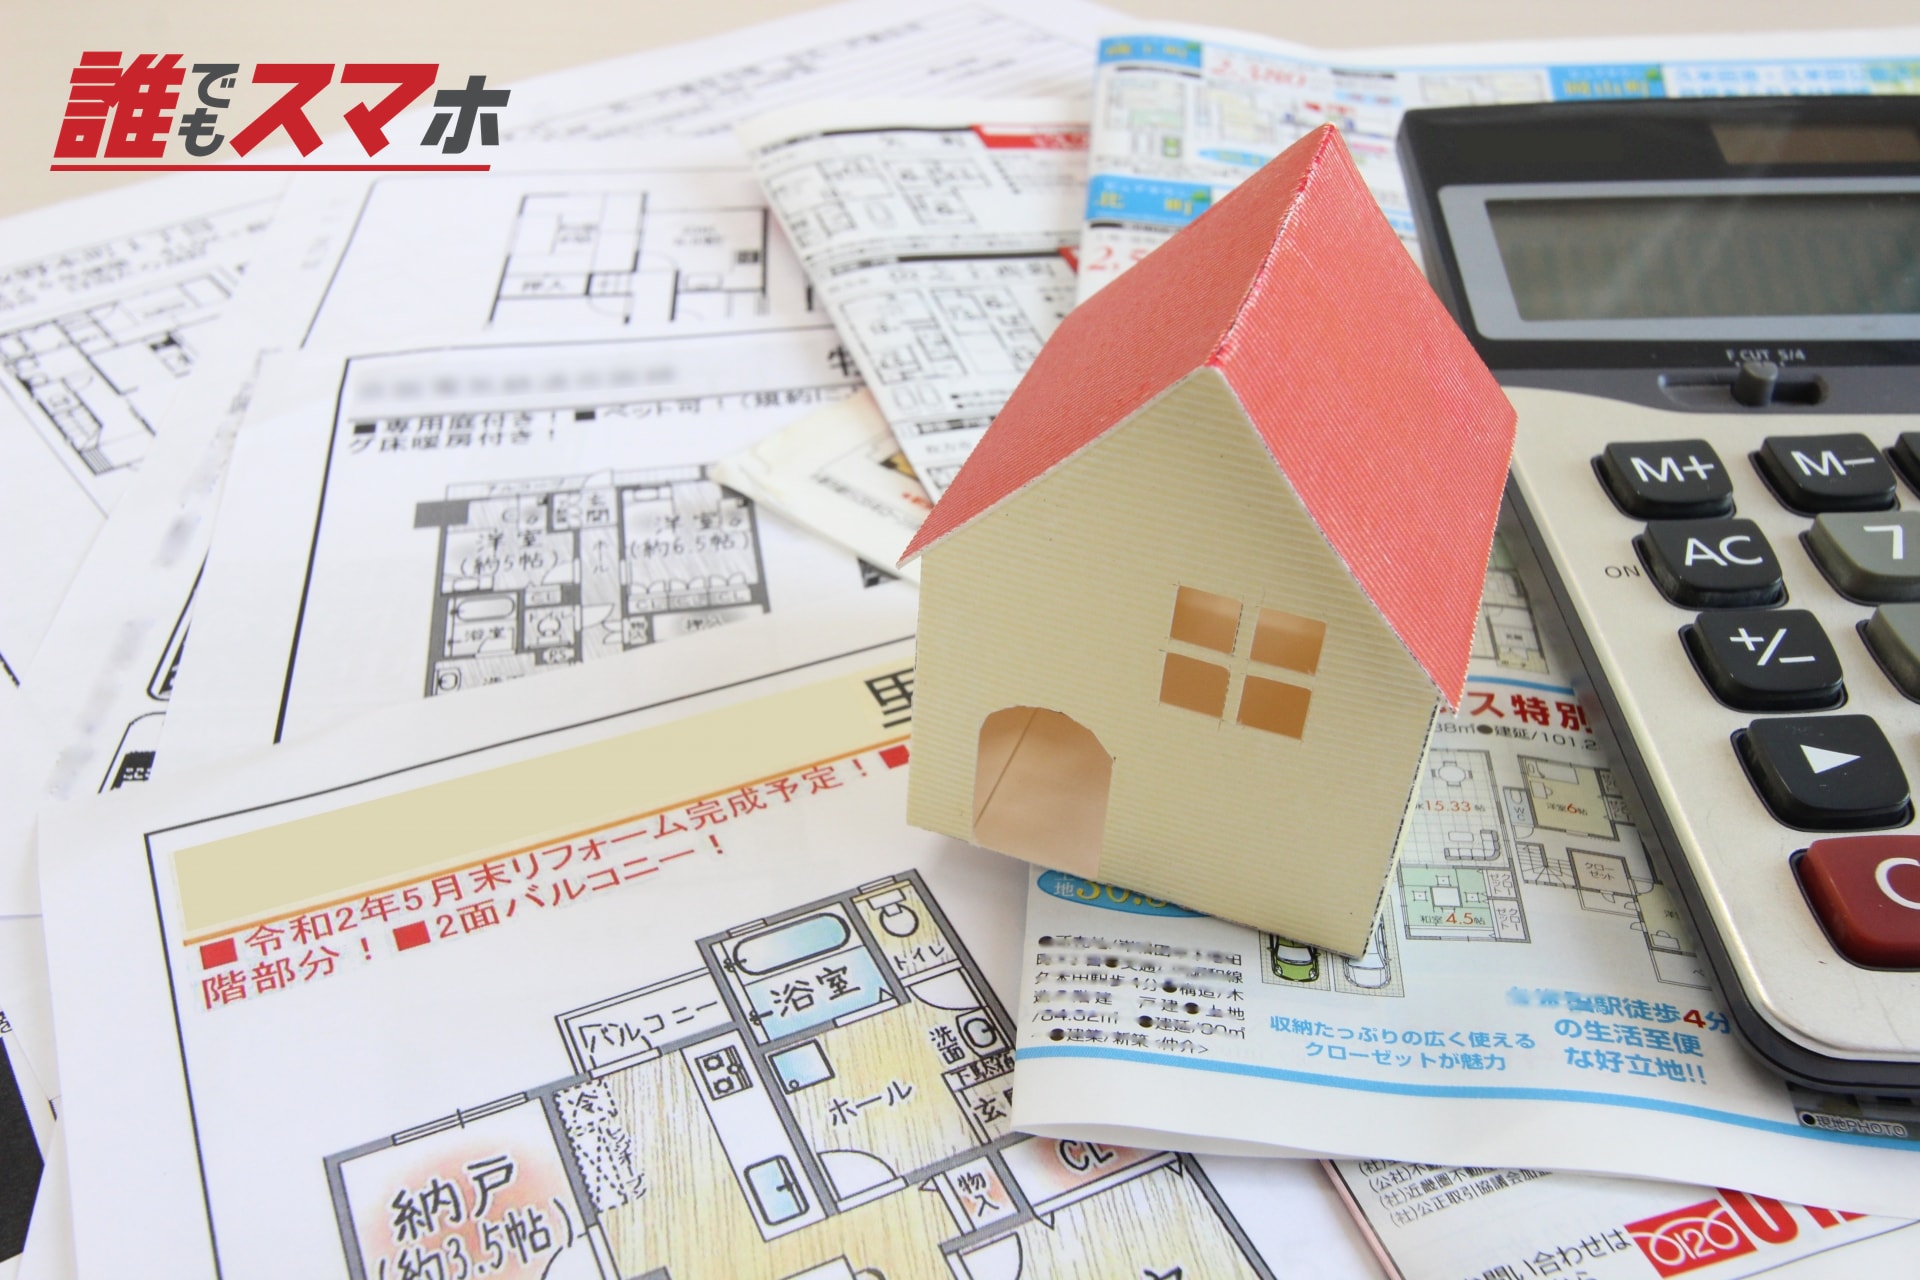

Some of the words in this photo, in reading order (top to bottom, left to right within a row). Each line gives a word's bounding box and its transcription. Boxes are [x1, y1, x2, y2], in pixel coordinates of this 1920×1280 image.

[1630, 454, 1715, 484] M+
[1683, 533, 1763, 567] AC
[1863, 524, 1904, 561] 7
[1604, 564, 1641, 579] ON
[1440, 691, 1593, 734] ス特別
[244, 758, 868, 956] 令和2年5月末リフォーム完成予定！
[202, 937, 372, 1010] 階部分！
[436, 833, 724, 940] 2面バルコニー！
[895, 945, 945, 972] トイレ
[770, 966, 862, 1018] 浴室
[1270, 1015, 1536, 1050] 収納たっぷりの広く使える
[1554, 1018, 1704, 1058] の生活至便
[1305, 1041, 1506, 1072] クローゼットが魅力
[828, 1080, 913, 1127] ホール
[974, 1086, 1014, 1123] 玄
[391, 1155, 515, 1243] 納戸
[956, 1171, 1000, 1218] 物入
